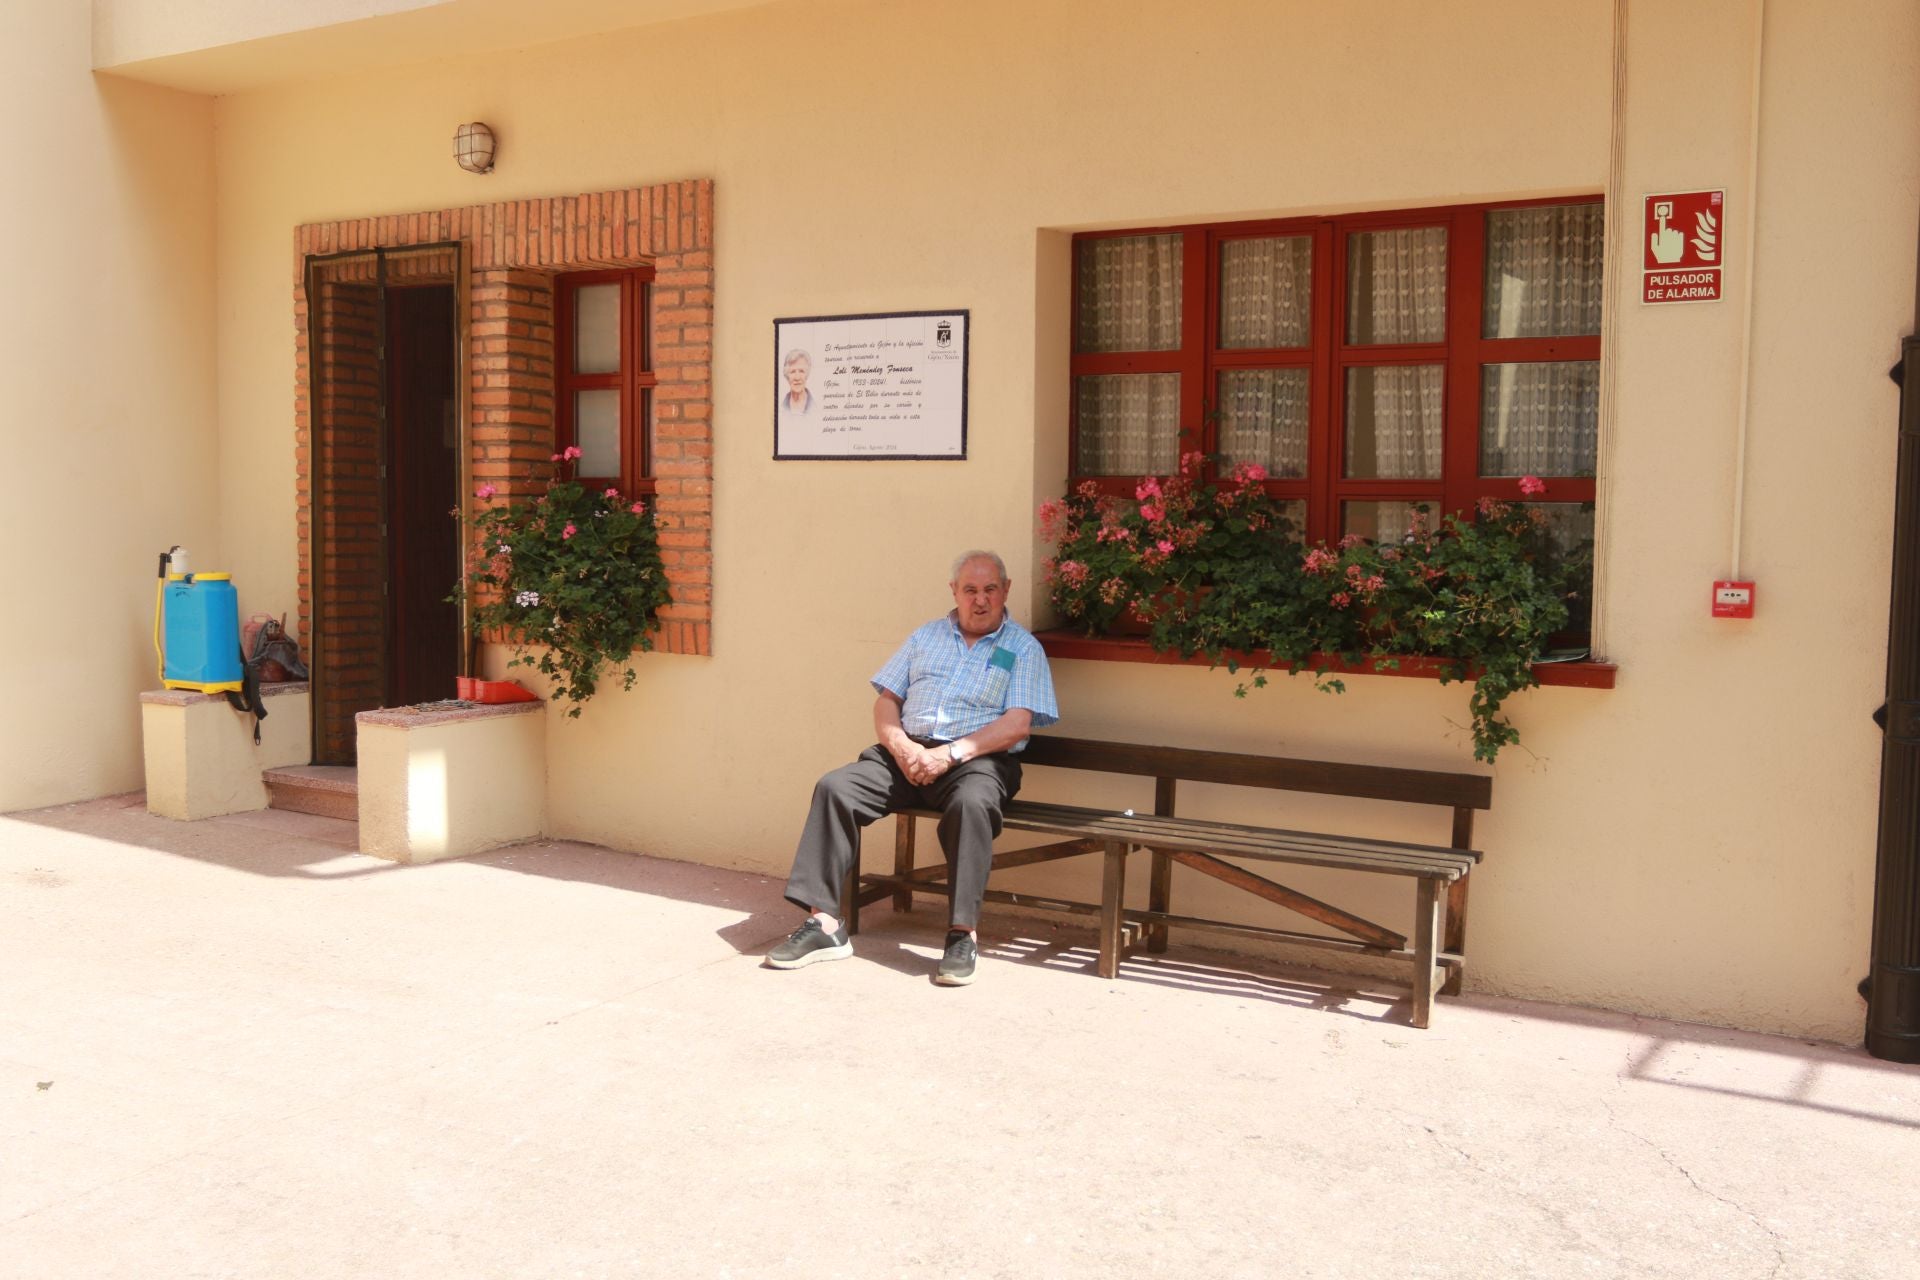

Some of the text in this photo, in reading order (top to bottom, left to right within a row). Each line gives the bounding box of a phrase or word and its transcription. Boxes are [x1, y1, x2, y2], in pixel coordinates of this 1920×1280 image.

[1650, 273, 1714, 286] PULSADOR
[1647, 286, 1716, 300] DE ALARMA
[832, 364, 913, 376] Loli Menéndez Fonseca
